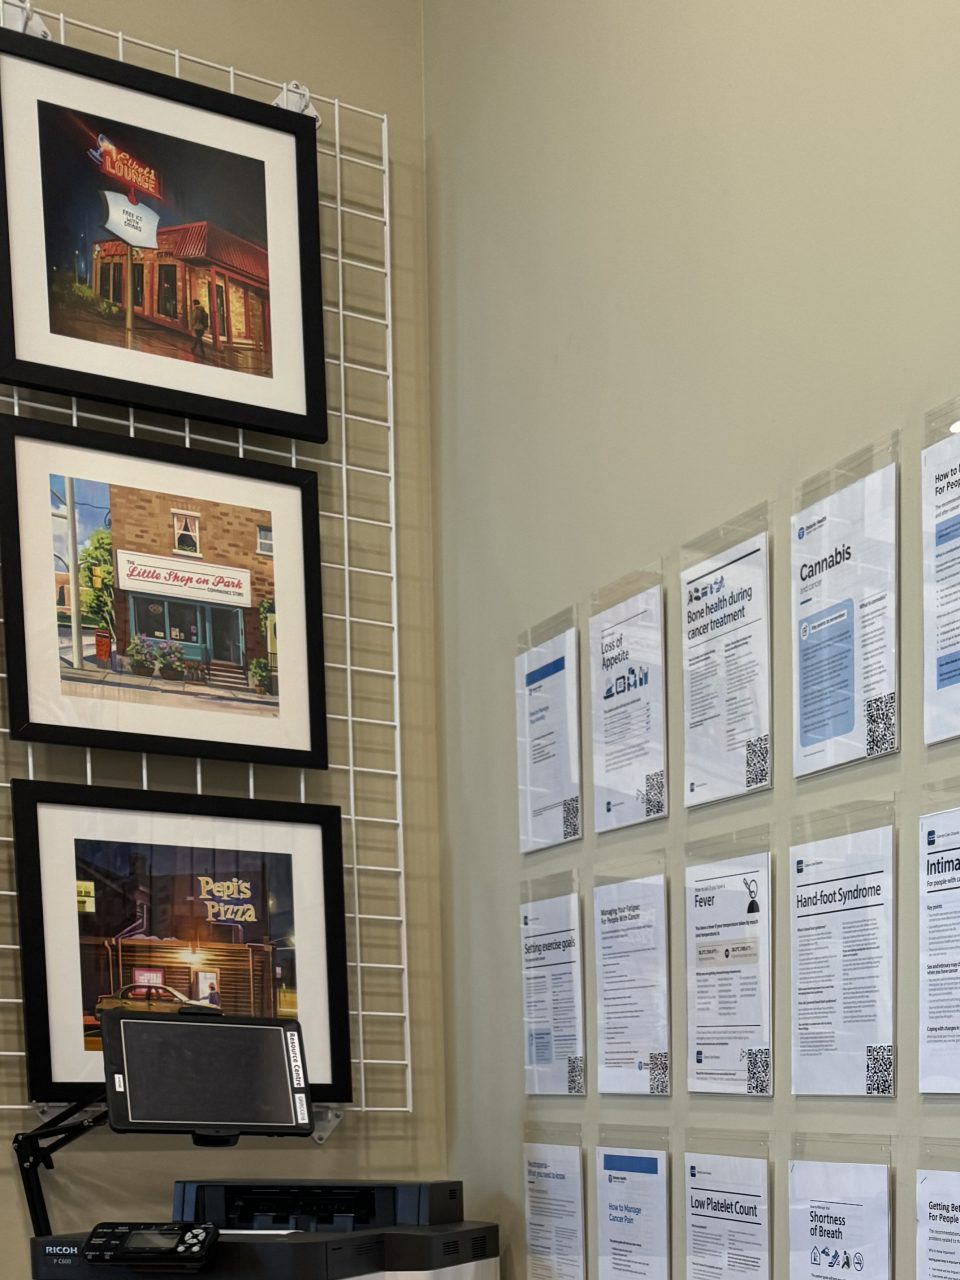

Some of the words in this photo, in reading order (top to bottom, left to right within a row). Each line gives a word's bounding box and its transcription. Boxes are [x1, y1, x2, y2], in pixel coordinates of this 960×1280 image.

[106, 156, 155, 192] LOUNGE
[935, 471, 949, 484] How
[951, 466, 957, 476] to
[935, 486, 945, 496] For
[800, 544, 851, 581] Cannabis
[126, 566, 161, 581] Little
[164, 571, 193, 586] Shop
[196, 578, 209, 586] on
[212, 575, 243, 589] Park
[688, 607, 704, 623] Bone
[705, 597, 727, 617] health
[728, 587, 752, 607] during
[688, 624, 709, 640] cancer
[710, 607, 745, 630] treatment
[601, 641, 615, 654] Loss
[616, 633, 622, 648] of
[602, 650, 629, 671] Appetite
[198, 876, 251, 899] Pepi's
[797, 890, 837, 908] Hand-foot
[838, 884, 881, 904] Syndrome
[695, 893, 714, 908] Fever
[206, 901, 257, 922] Pizza
[525, 942, 541, 955] Setting
[543, 939, 561, 953] exercise
[562, 936, 575, 951] goals
[289, 1032, 298, 1063] Resource
[609, 1203, 618, 1212] How
[619, 1204, 623, 1212] to
[625, 1204, 641, 1215] Manage
[691, 1195, 705, 1209] Low
[706, 1197, 734, 1214] Platelet
[735, 1201, 757, 1217] Count
[929, 1201, 949, 1214] Getting
[609, 1214, 623, 1224] Cancer
[625, 1215, 634, 1224] Pain
[810, 1211, 845, 1226] Shortness
[929, 1213, 937, 1222] For
[939, 1214, 959, 1226] People
[810, 1226, 818, 1237] of
[819, 1226, 842, 1240] Breath
